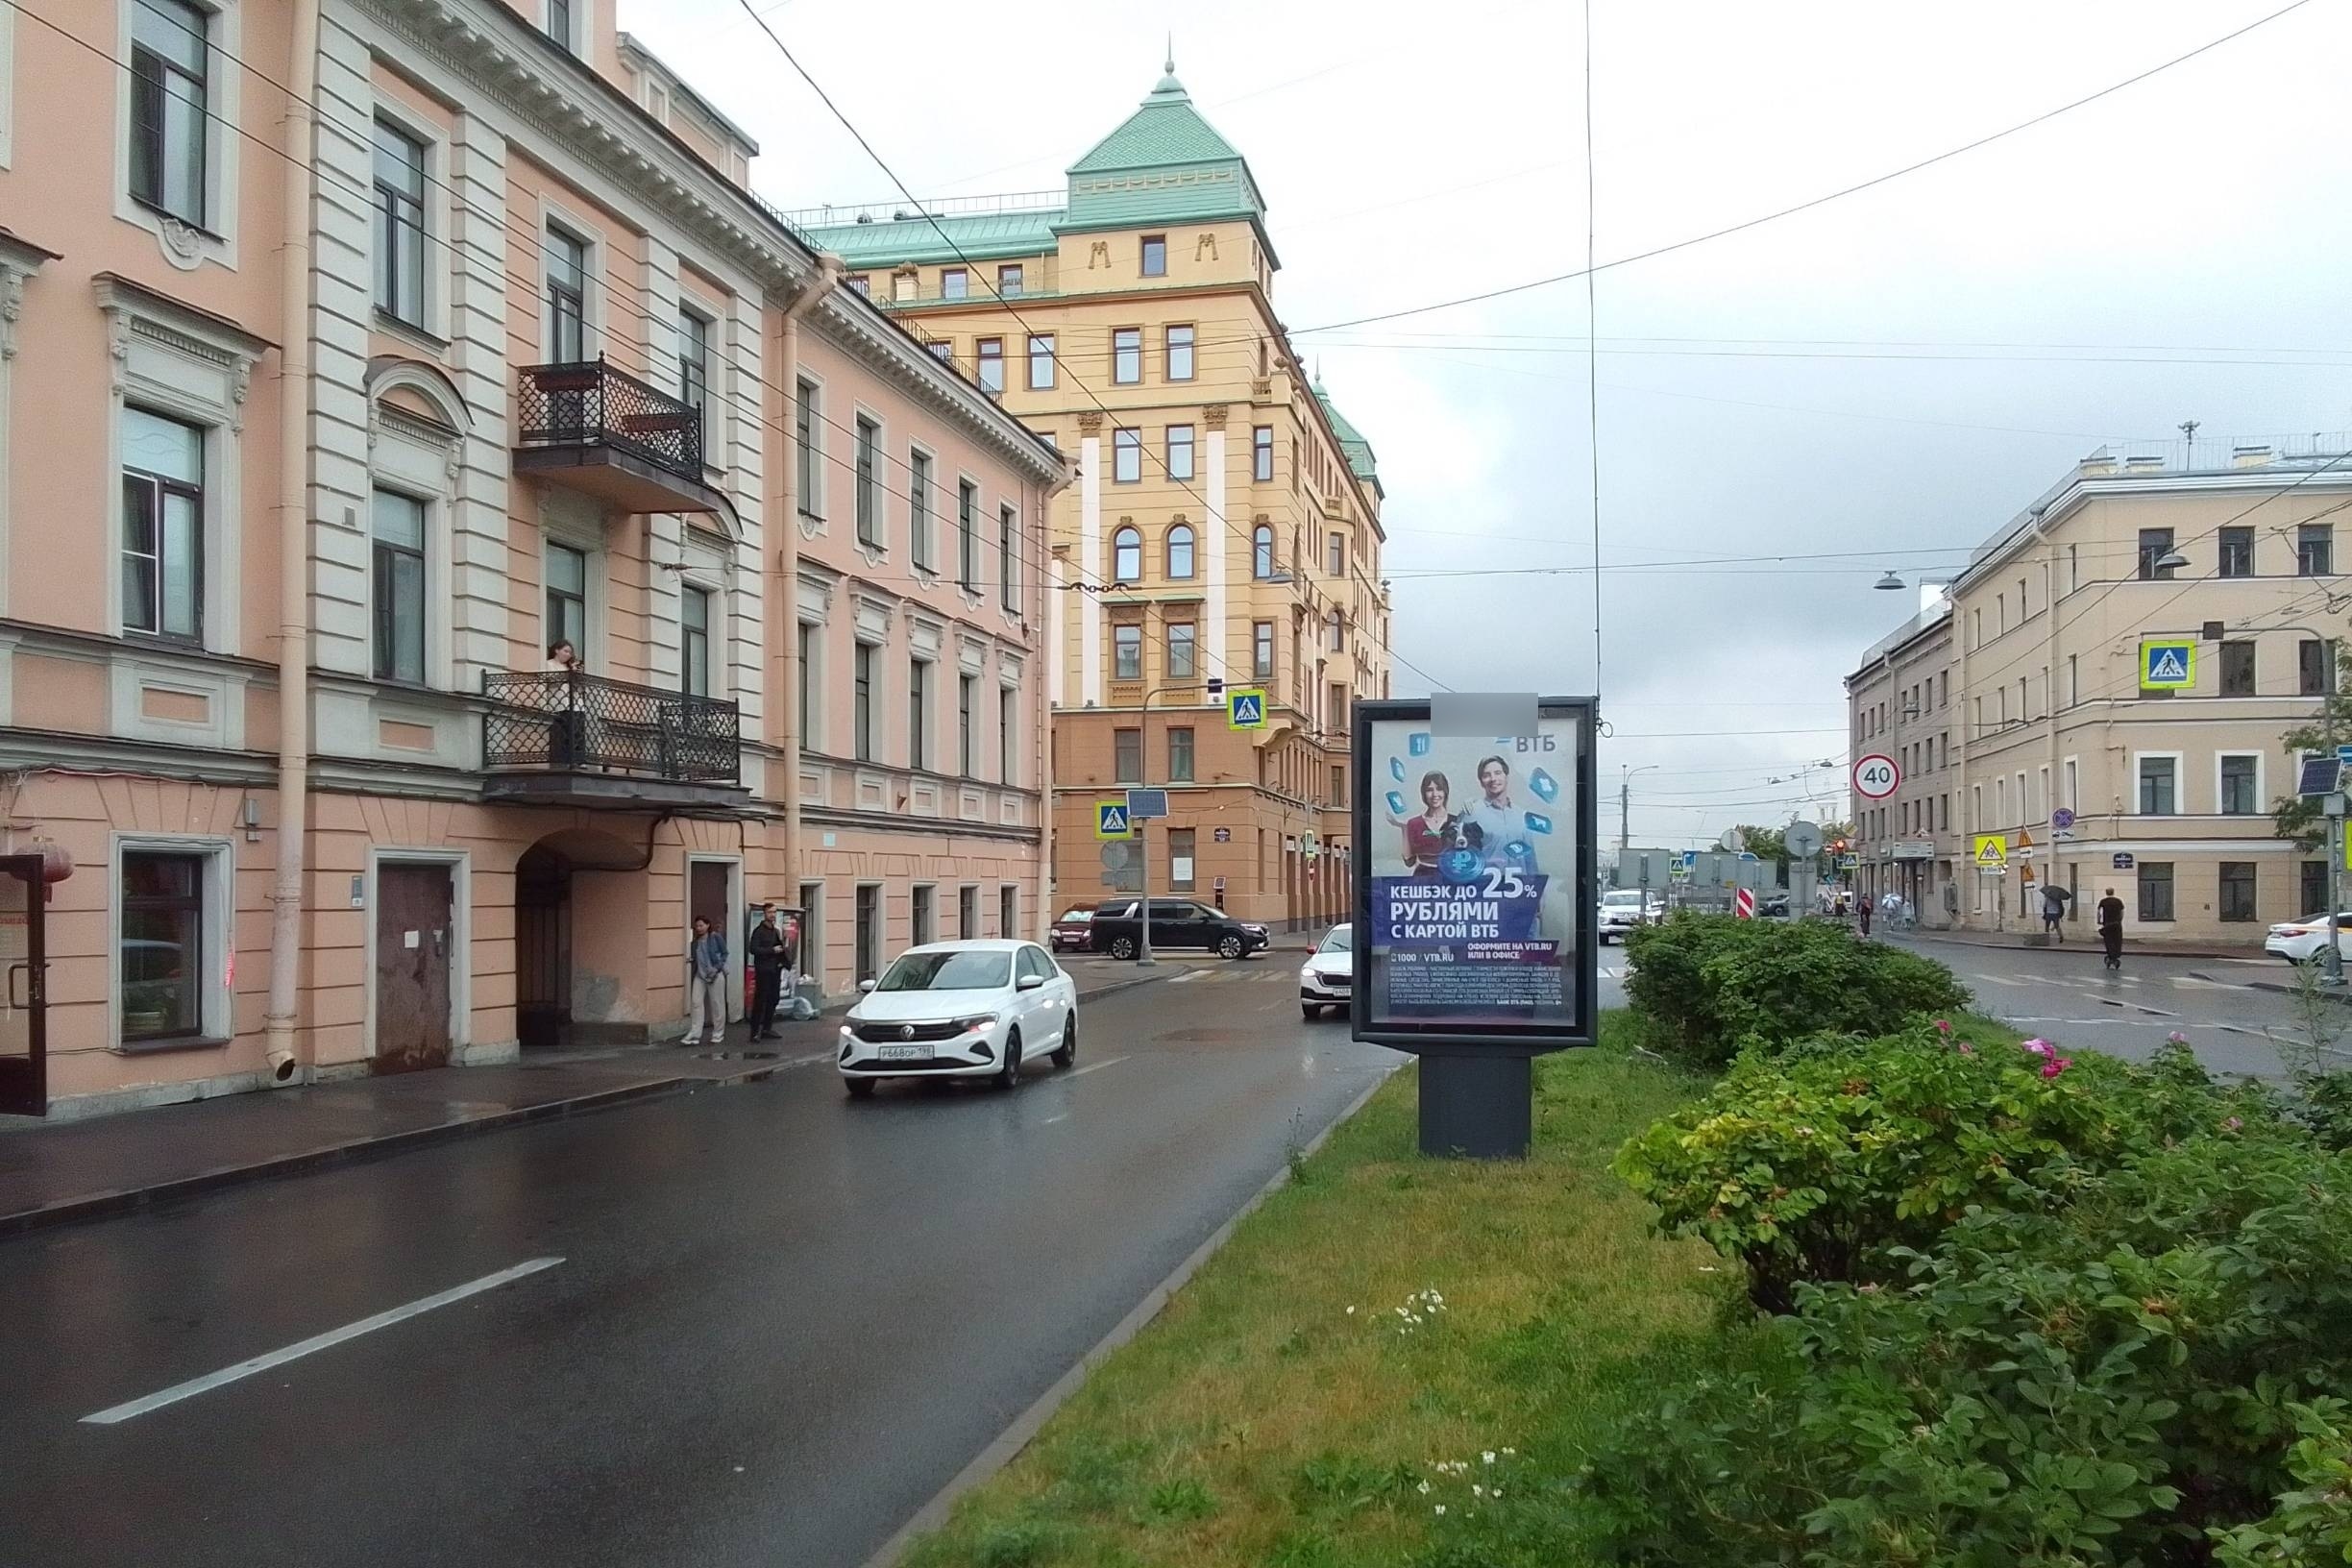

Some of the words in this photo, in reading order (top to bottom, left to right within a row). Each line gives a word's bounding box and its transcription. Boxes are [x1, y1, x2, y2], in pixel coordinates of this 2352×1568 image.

[1516, 734, 1556, 752] ВТБ
[1864, 767, 1891, 784] 40
[1390, 886, 1452, 899] КЕШБЭК
[1455, 886, 1478, 901] ДО
[1482, 867, 1538, 899] 25%
[1390, 902, 1500, 921] РУБЛЯМИ
[1391, 925, 1402, 939] С
[1405, 922, 1467, 939] КАРТОЙ
[1471, 925, 1500, 939] ВТБ
[1467, 943, 1511, 951] ОФОРМИТЕ
[1397, 953, 1417, 962] 1000
[1423, 953, 1455, 962] VTB.RU
